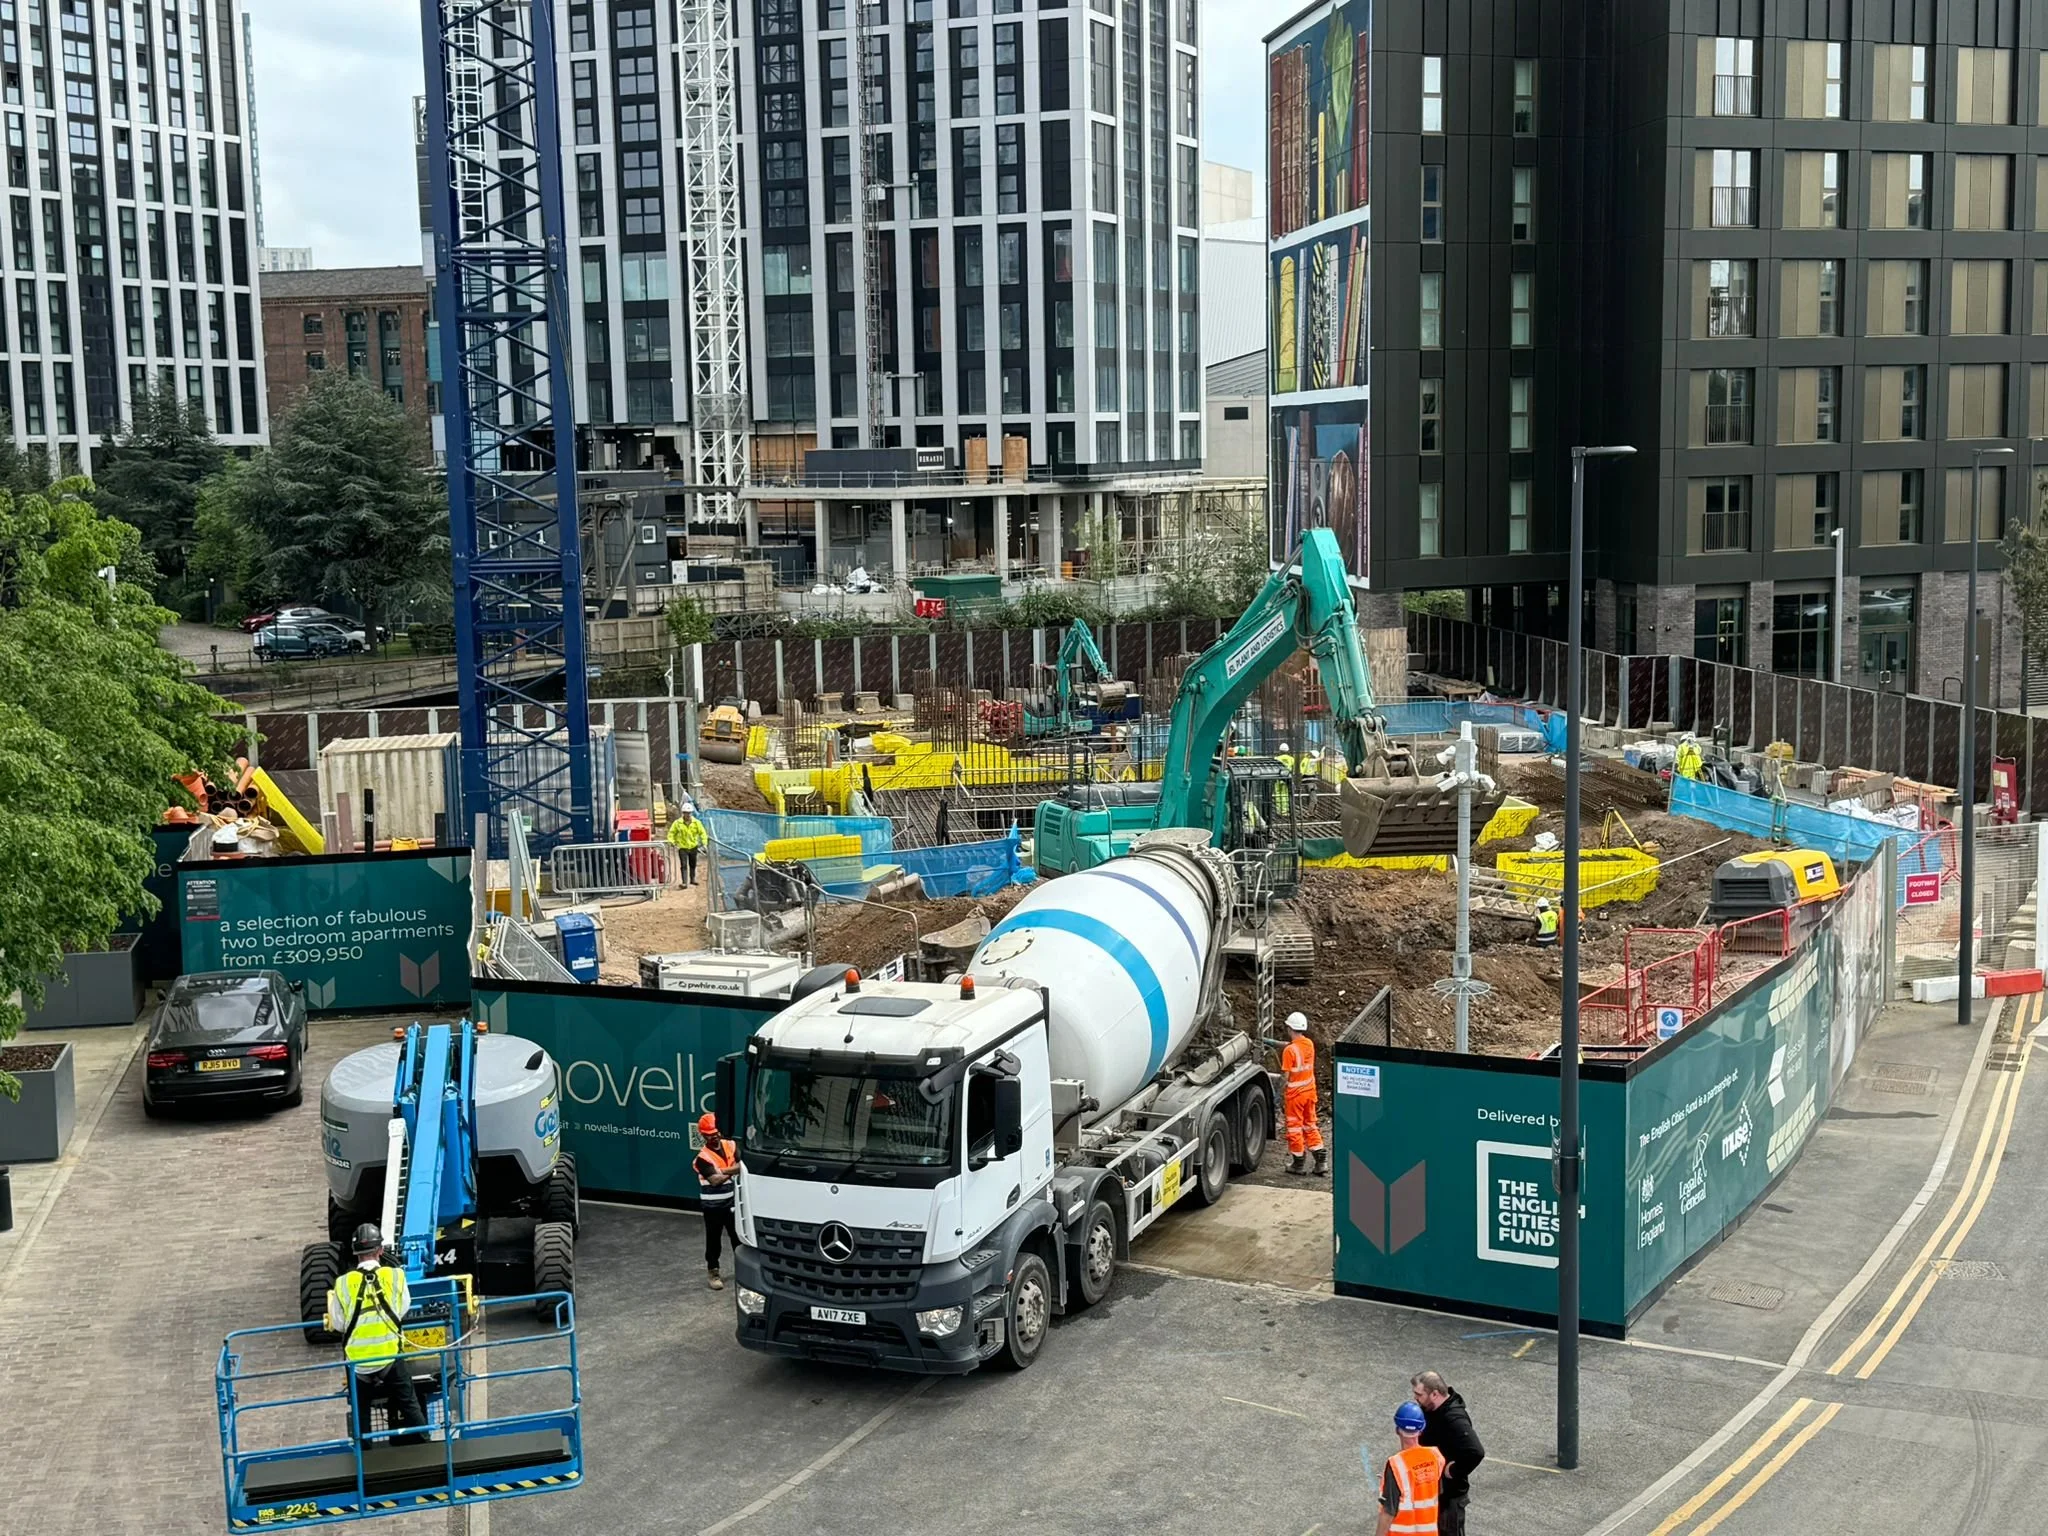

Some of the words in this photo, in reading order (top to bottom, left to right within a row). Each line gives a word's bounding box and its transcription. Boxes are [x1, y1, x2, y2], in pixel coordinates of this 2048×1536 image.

[1235, 650, 1250, 669] PLANT
[1250, 641, 1261, 657] AND
[1260, 621, 1284, 647] LOGISTICS
[1909, 880, 1937, 888] FOOTWAY
[1911, 890, 1935, 898] CLOSED
[220, 920, 231, 932] a
[237, 914, 319, 931] selection
[325, 910, 344, 926] of
[349, 907, 427, 924] fabulous
[221, 935, 257, 949] two
[263, 930, 346, 947] bedroom
[351, 923, 455, 944] apartments
[222, 952, 265, 967] from
[272, 945, 364, 965] £309,950
[688, 980, 740, 991] pwhire.co.uk
[1345, 1066, 1374, 1076] NOTICE
[1477, 1108, 1545, 1126] Delivered
[1550, 1115, 1561, 1127] b
[1639, 1133, 1650, 1148] The
[1651, 1118, 1670, 1141] English
[1671, 1110, 1685, 1126] Cities
[1685, 1098, 1697, 1117] Fund
[1698, 1096, 1703, 1107] is
[1707, 1074, 1731, 1104] partnership
[585, 1123, 681, 1140] novella-salford.com
[1722, 1122, 1749, 1160] muse
[1498, 1179, 1538, 1197] THE
[1679, 1170, 1697, 1200] Legal
[1499, 1195, 1586, 1219] ENGLIH
[1681, 1182, 1706, 1215] General
[1498, 1211, 1560, 1232] CITIES
[1641, 1202, 1663, 1226] Homes
[1499, 1227, 1555, 1247] FUND
[1641, 1216, 1665, 1248] England
[434, 1249, 456, 1265] x4
[817, 1309, 839, 1320] AV17
[841, 1311, 860, 1323] ZXE
[286, 1501, 317, 1516] 2243
